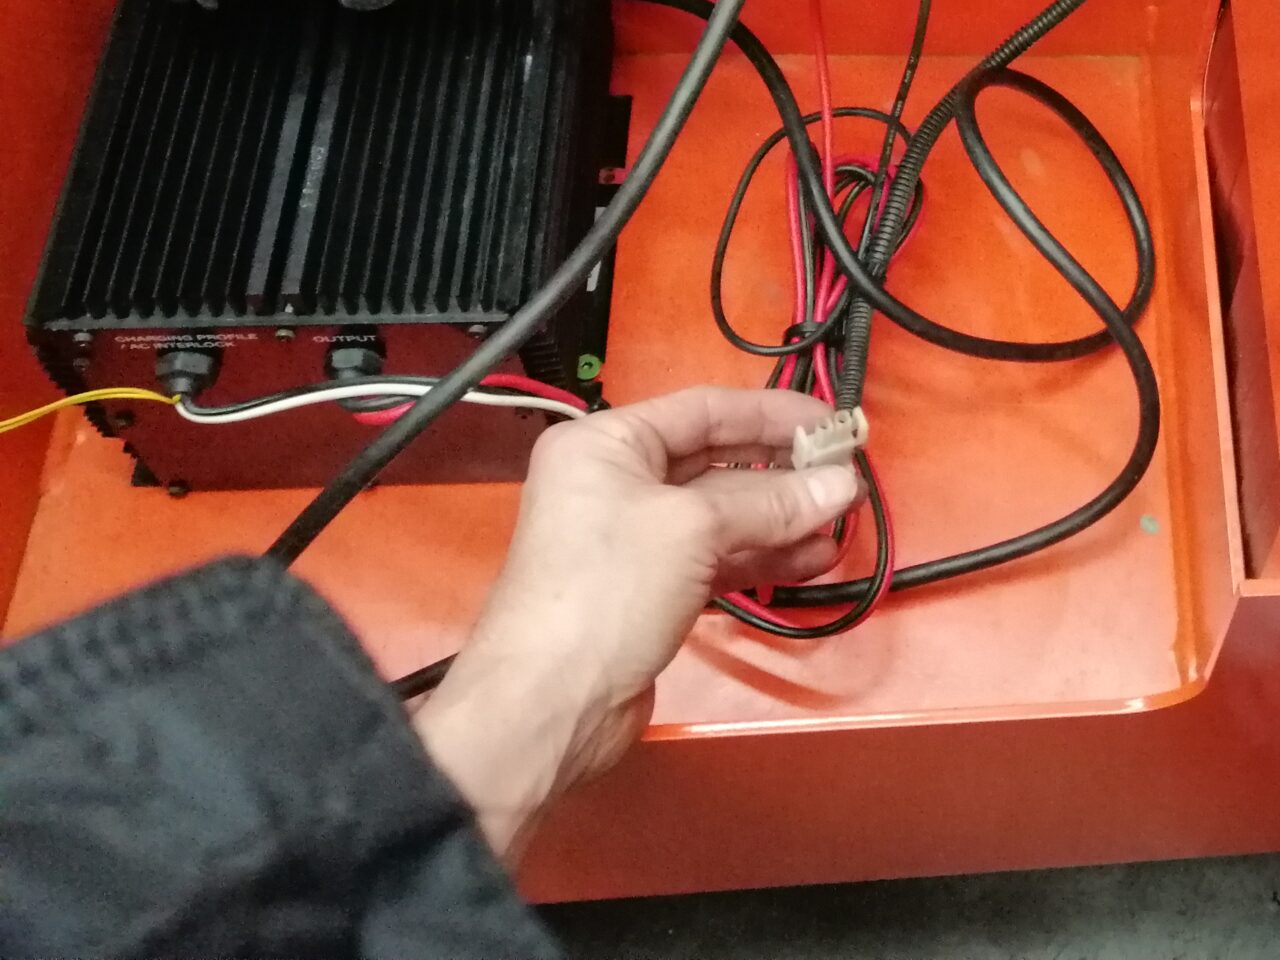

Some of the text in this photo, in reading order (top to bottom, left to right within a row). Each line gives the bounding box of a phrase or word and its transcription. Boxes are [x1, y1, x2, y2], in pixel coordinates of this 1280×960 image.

[115, 333, 258, 343] CHARGING PROFILE
[313, 335, 377, 343] OUTPUT
